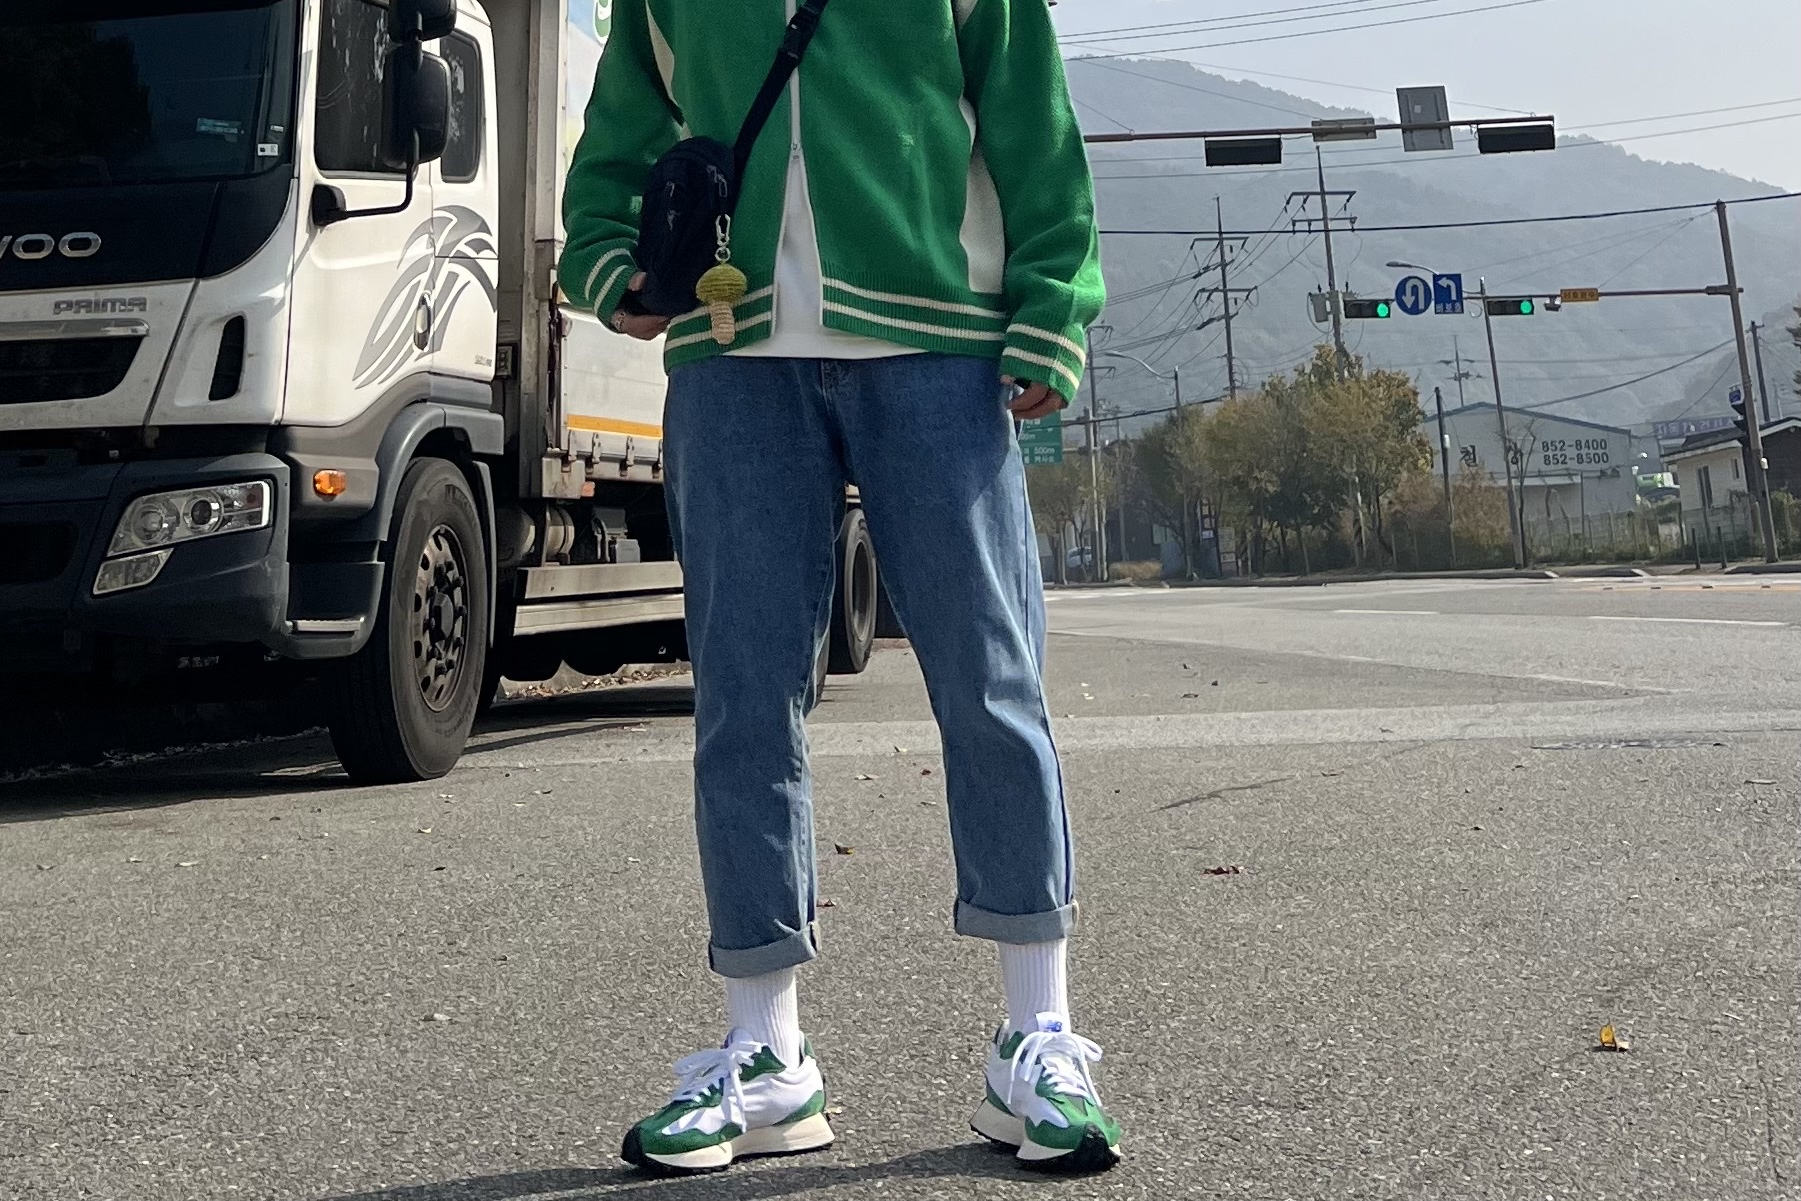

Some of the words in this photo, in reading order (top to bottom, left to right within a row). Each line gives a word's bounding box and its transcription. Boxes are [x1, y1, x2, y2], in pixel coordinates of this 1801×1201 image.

[0, 231, 101, 260] OO
[1541, 439, 1607, 453] 852-8400
[1543, 452, 1609, 466] 852-8500
